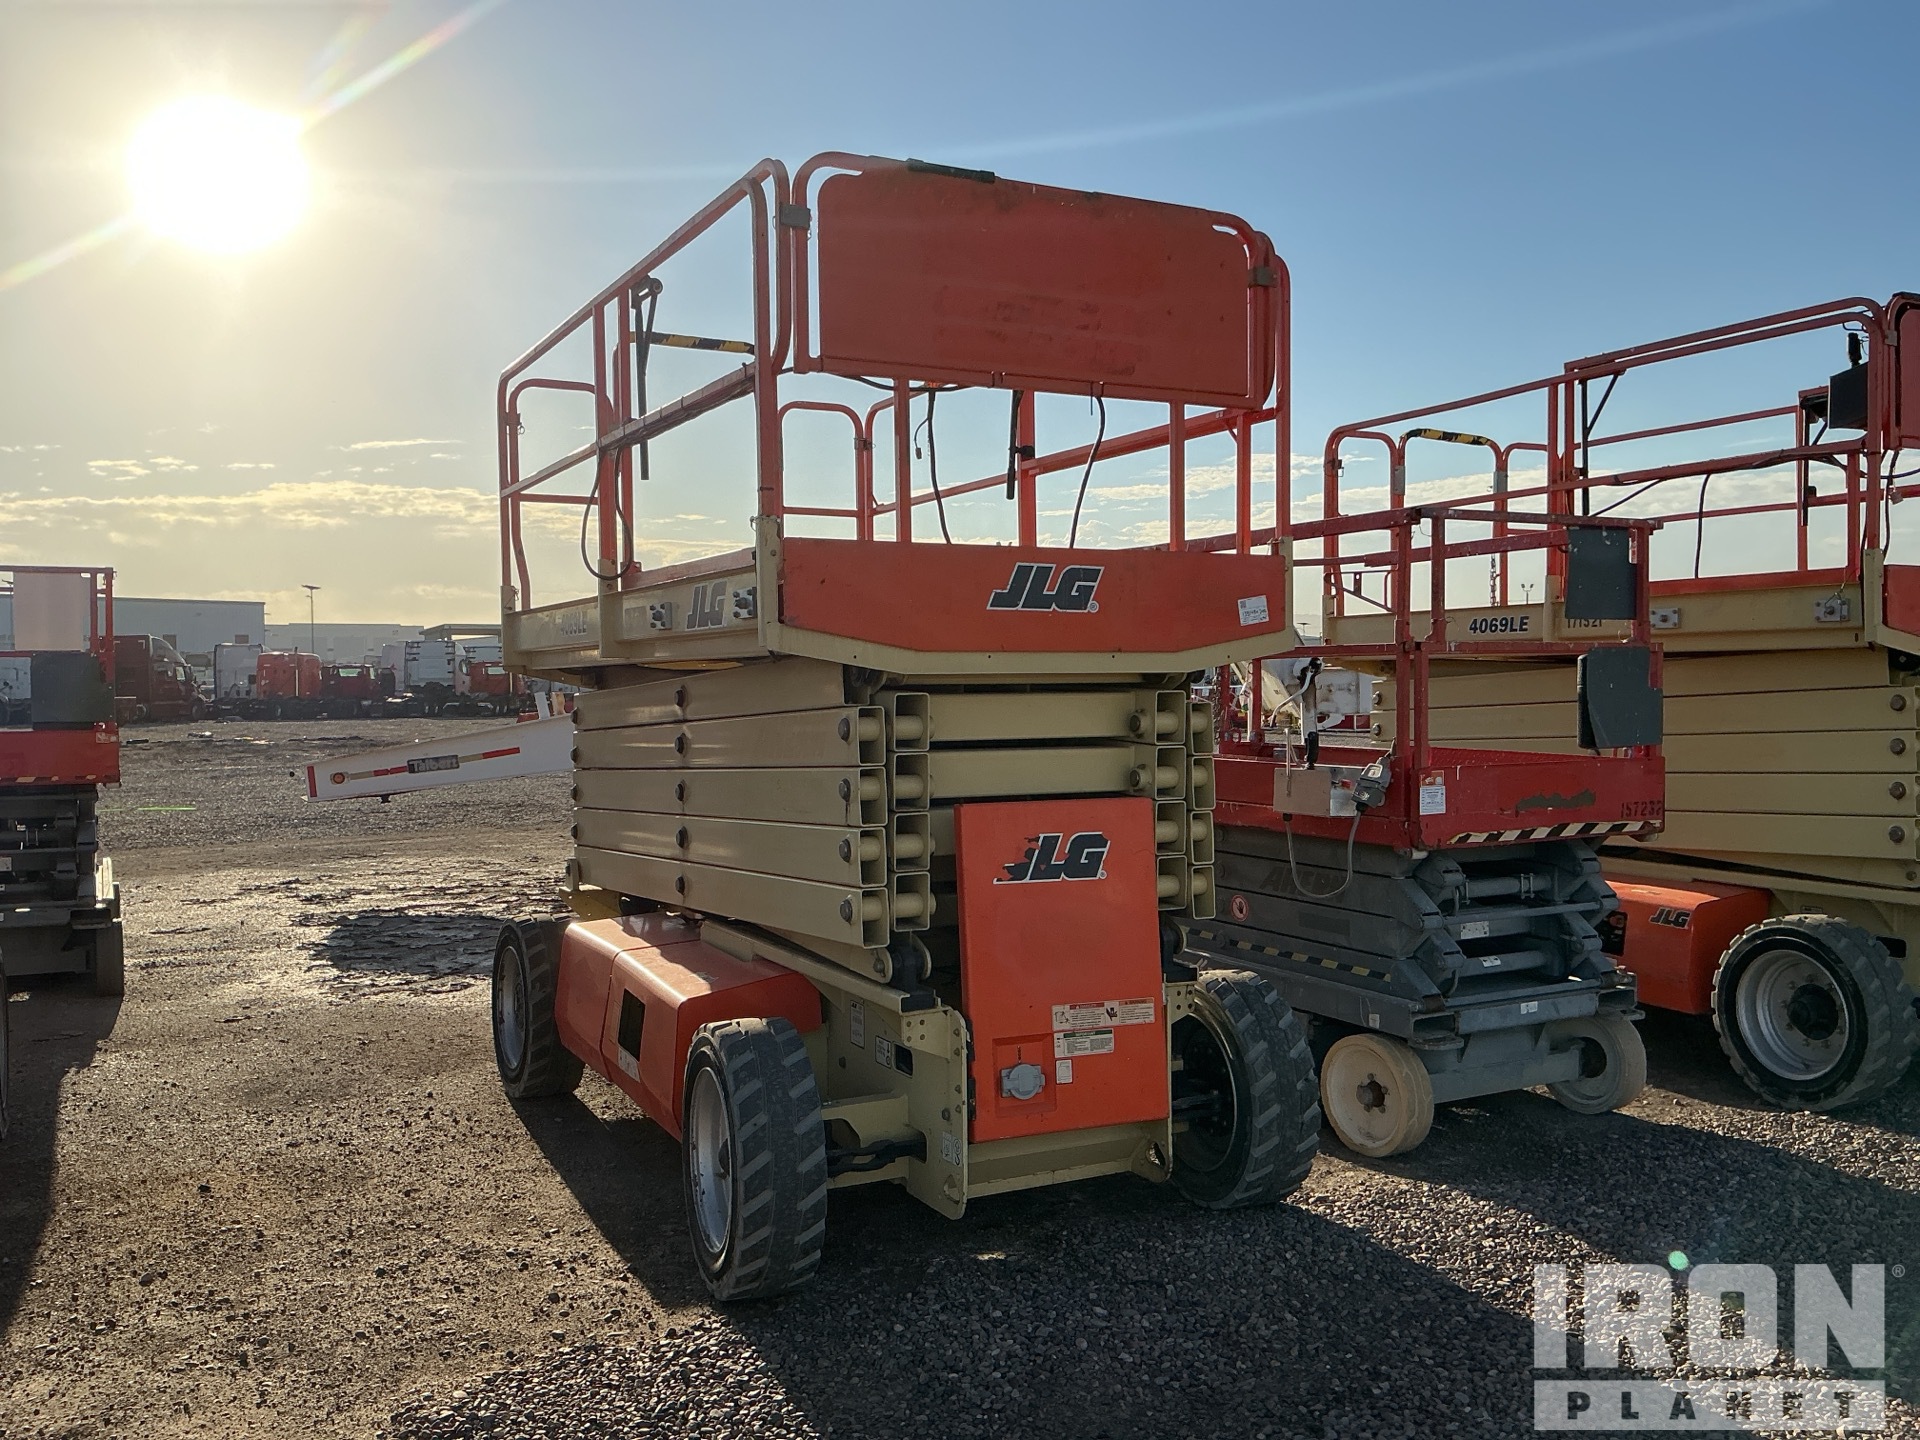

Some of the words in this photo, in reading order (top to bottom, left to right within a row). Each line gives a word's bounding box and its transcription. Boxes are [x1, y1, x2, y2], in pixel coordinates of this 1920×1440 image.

[987, 562, 1104, 612] JLG
[685, 580, 728, 631] JLG
[1469, 616, 1529, 633] 4069LE
[1648, 907, 1692, 929] JLG
